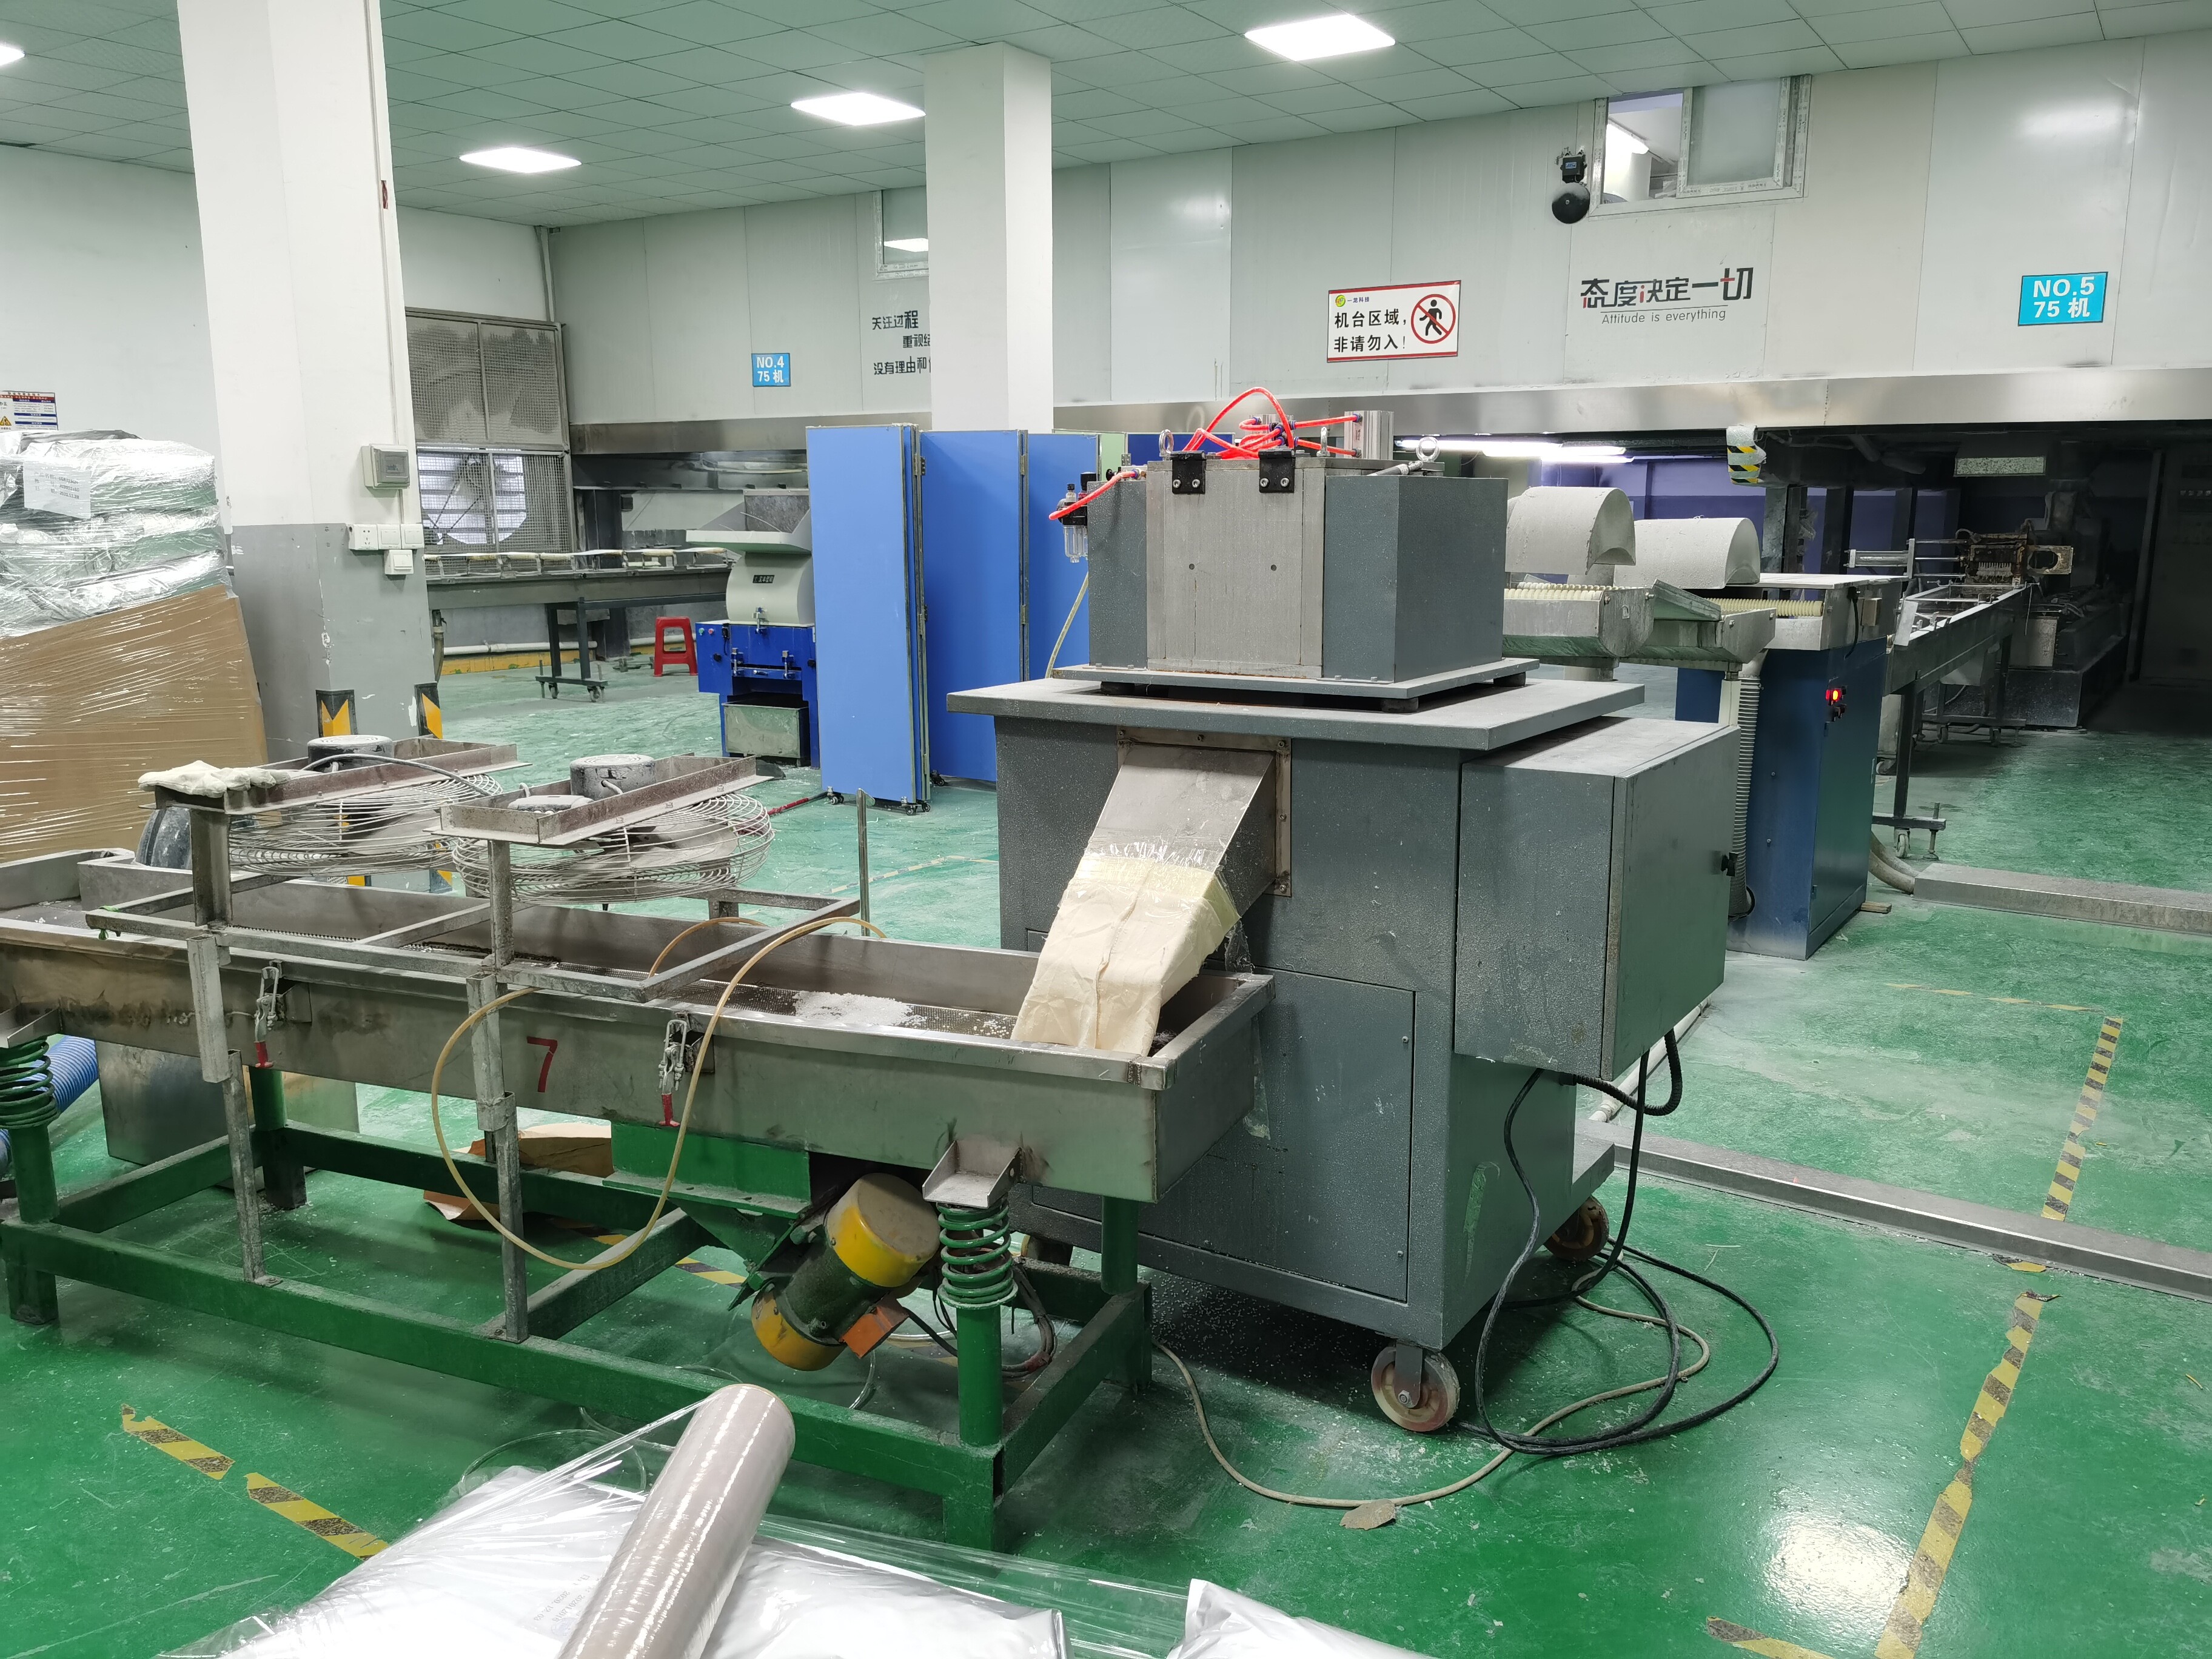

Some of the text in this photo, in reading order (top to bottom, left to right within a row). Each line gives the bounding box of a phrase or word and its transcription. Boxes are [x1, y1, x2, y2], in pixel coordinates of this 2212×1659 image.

[1581, 267, 1754, 309] 态度决定一切
[2033, 276, 2094, 298] NO.5
[1602, 309, 1726, 324] Attitude is everything
[2034, 297, 2090, 318] 75 机
[757, 356, 785, 368] NO.4
[874, 356, 931, 375] 没有理由和
[757, 369, 784, 383] 75 机
[526, 1036, 558, 1093] 7
